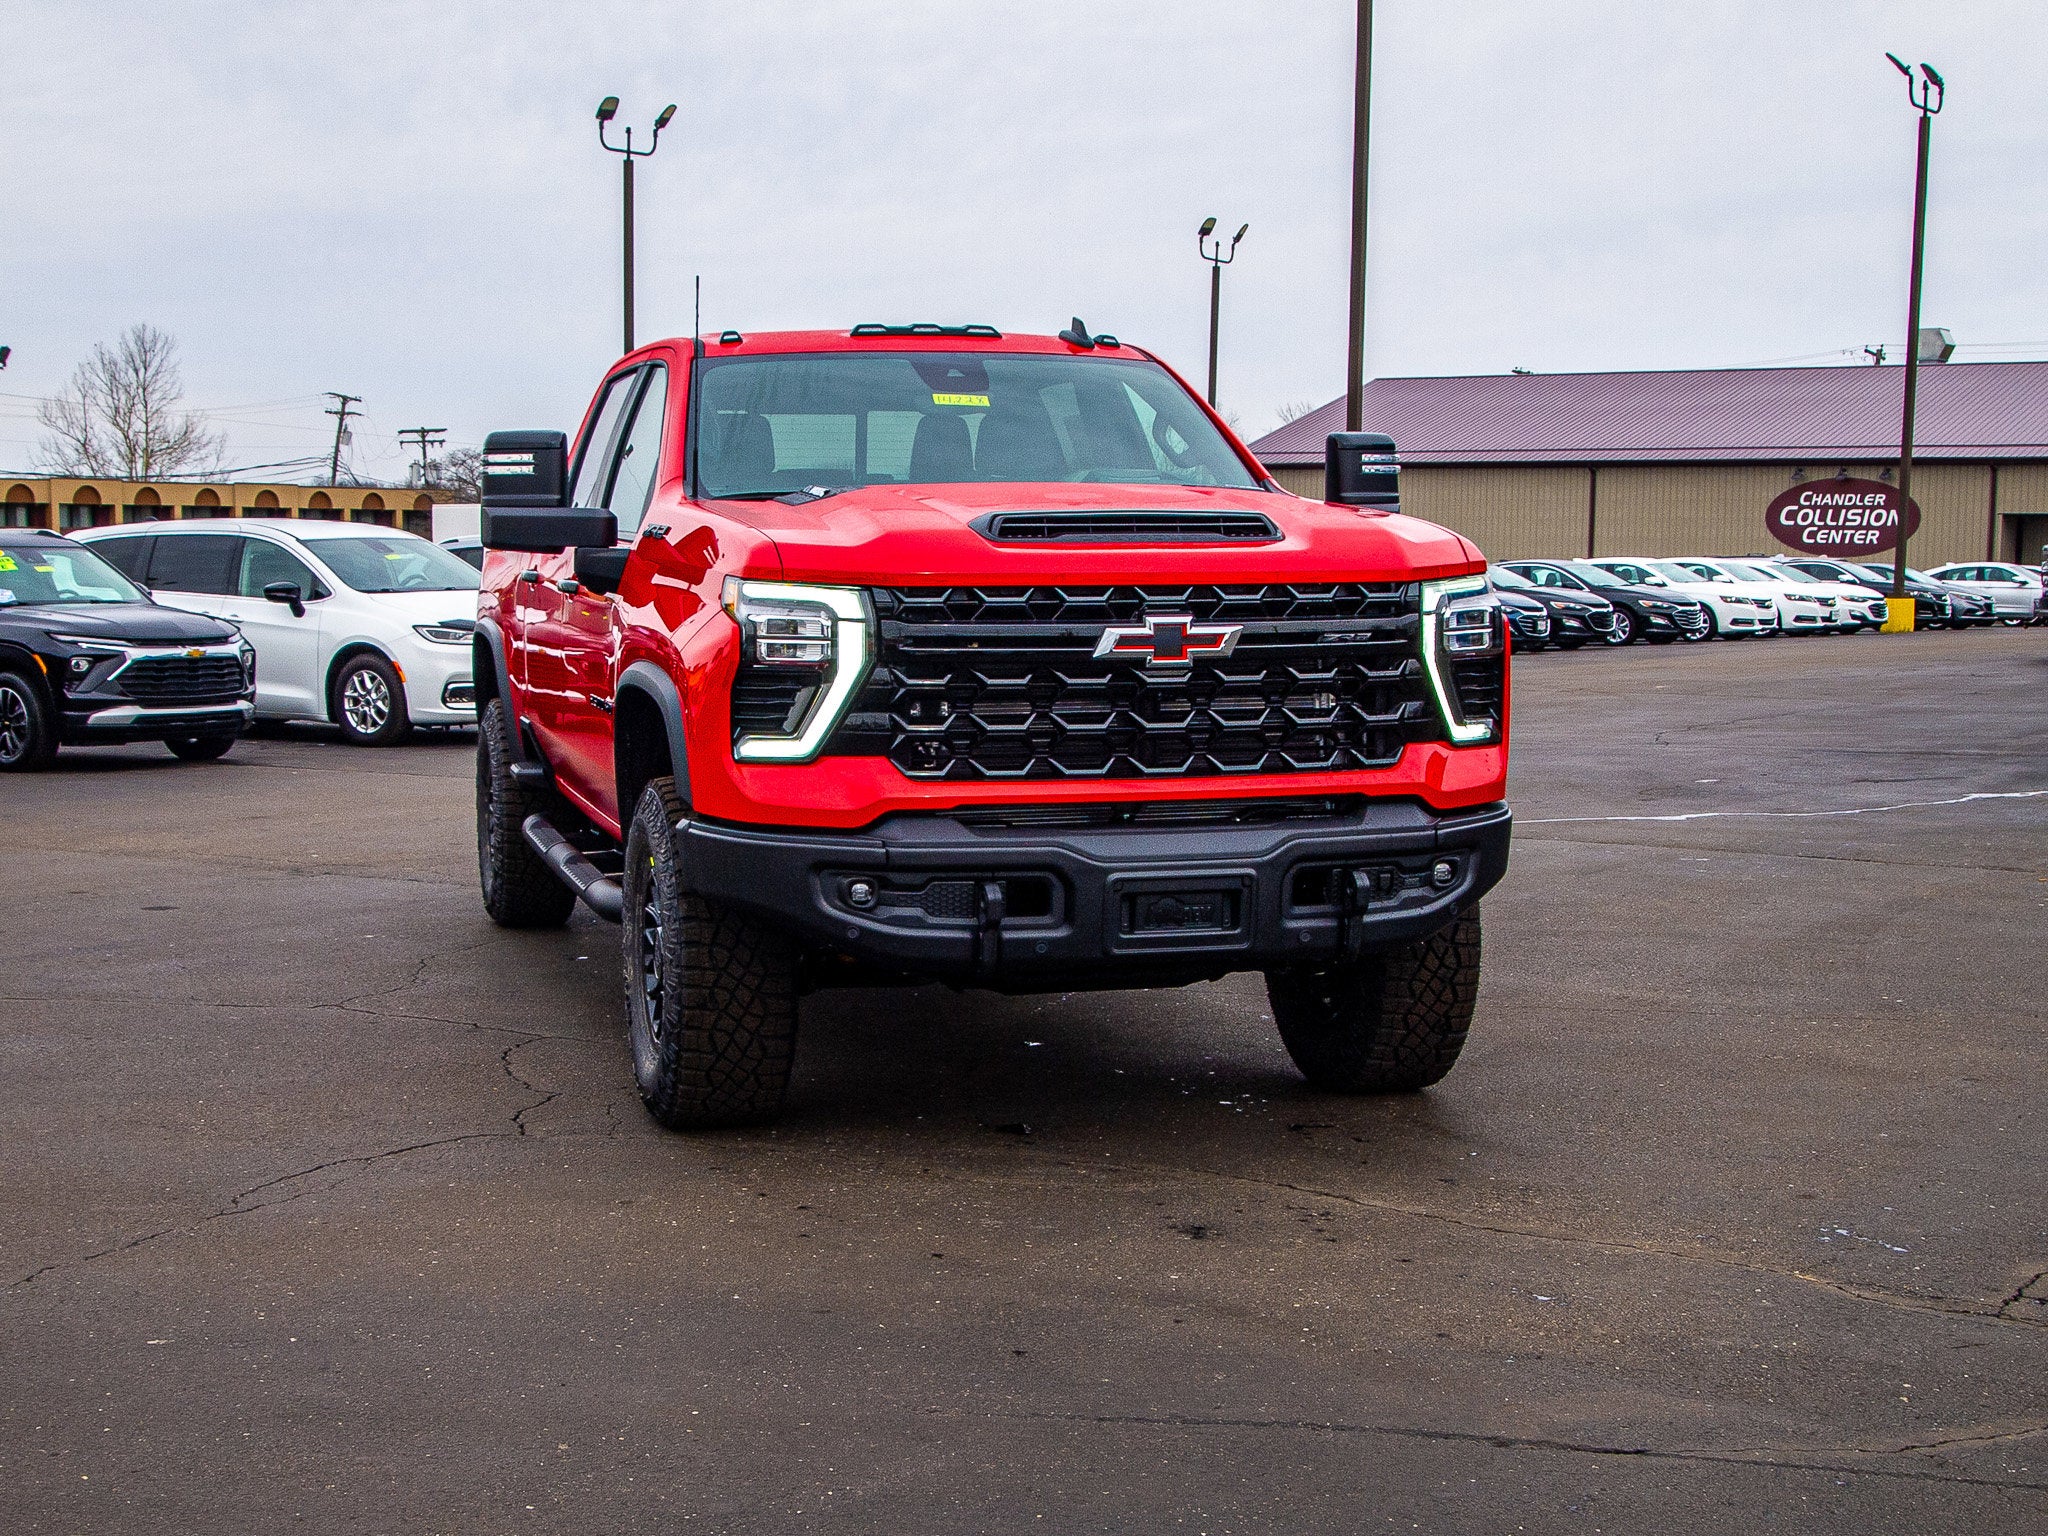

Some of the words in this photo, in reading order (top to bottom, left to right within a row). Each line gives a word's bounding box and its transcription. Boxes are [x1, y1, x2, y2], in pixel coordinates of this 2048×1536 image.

[1800, 491, 1886, 506] CHANDLER
[1779, 505, 1899, 527] COLLISION
[1802, 526, 1881, 545] CENTER
